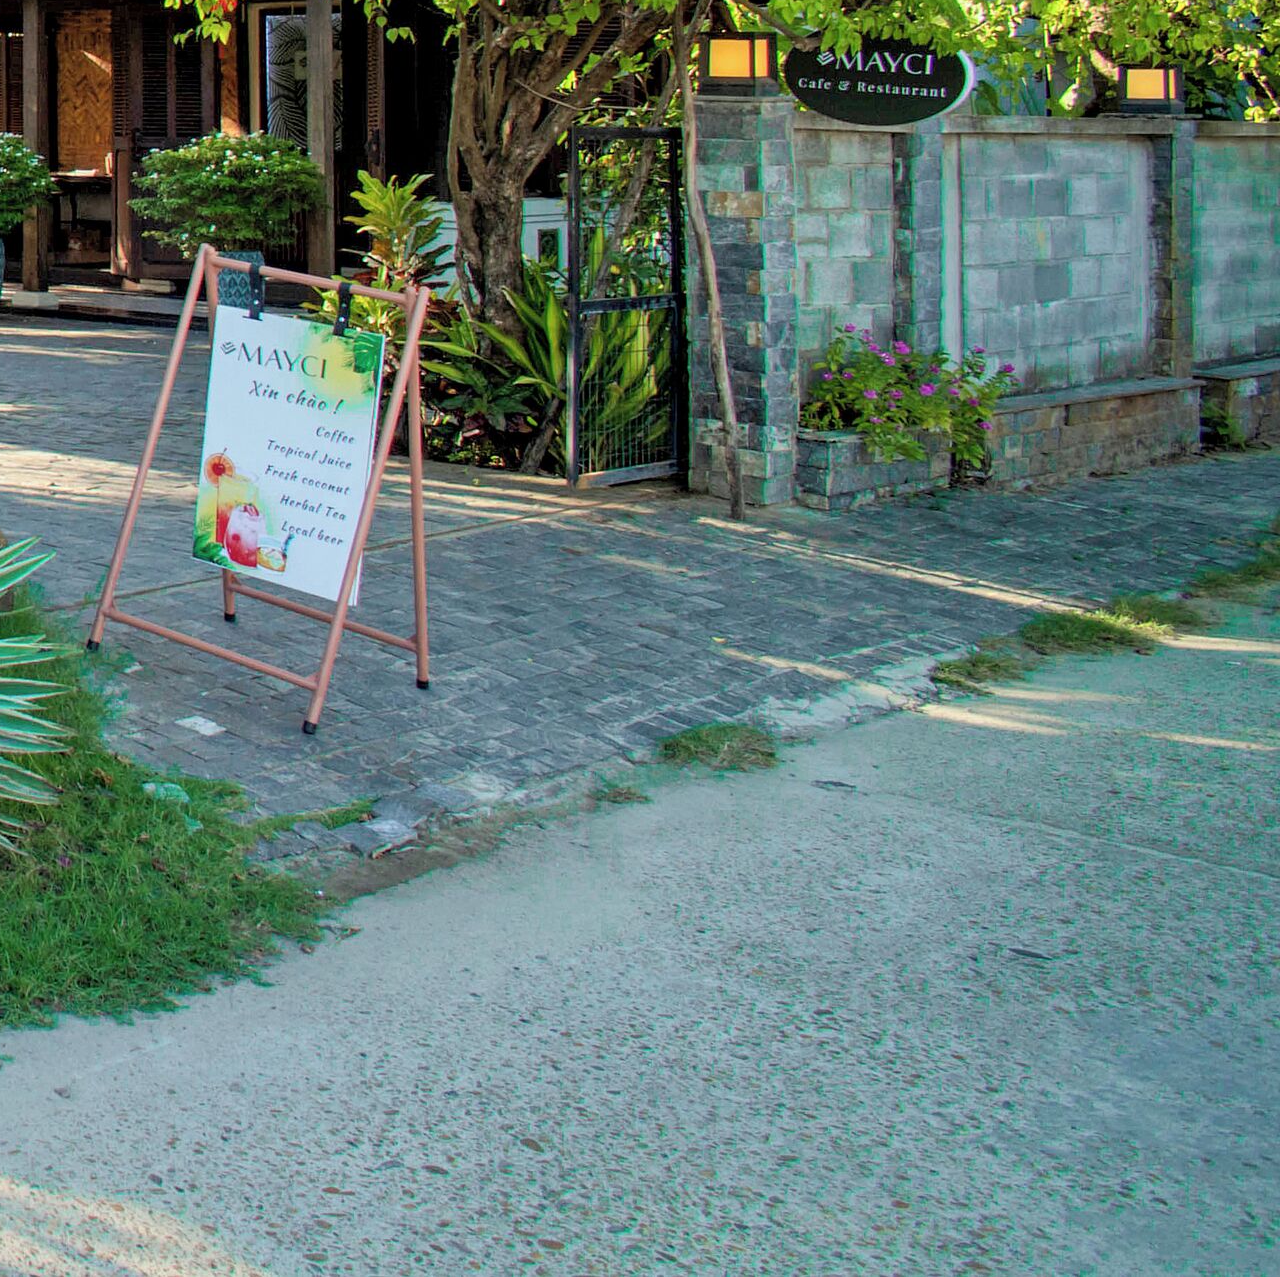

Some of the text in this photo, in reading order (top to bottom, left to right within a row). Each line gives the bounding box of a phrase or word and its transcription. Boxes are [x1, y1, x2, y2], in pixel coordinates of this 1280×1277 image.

[835, 51, 934, 75] MAYCI
[797, 77, 948, 99] Cafe & Restaurant
[237, 342, 327, 379] MAYCI
[248, 380, 279, 400] Xin
[286, 389, 328, 411] chào
[315, 426, 355, 444] Coffee
[266, 439, 352, 470] Tropical Juice
[265, 464, 350, 495] Fresh coconut
[280, 494, 347, 521] Herbal Tea
[281, 520, 344, 545] Local beer
